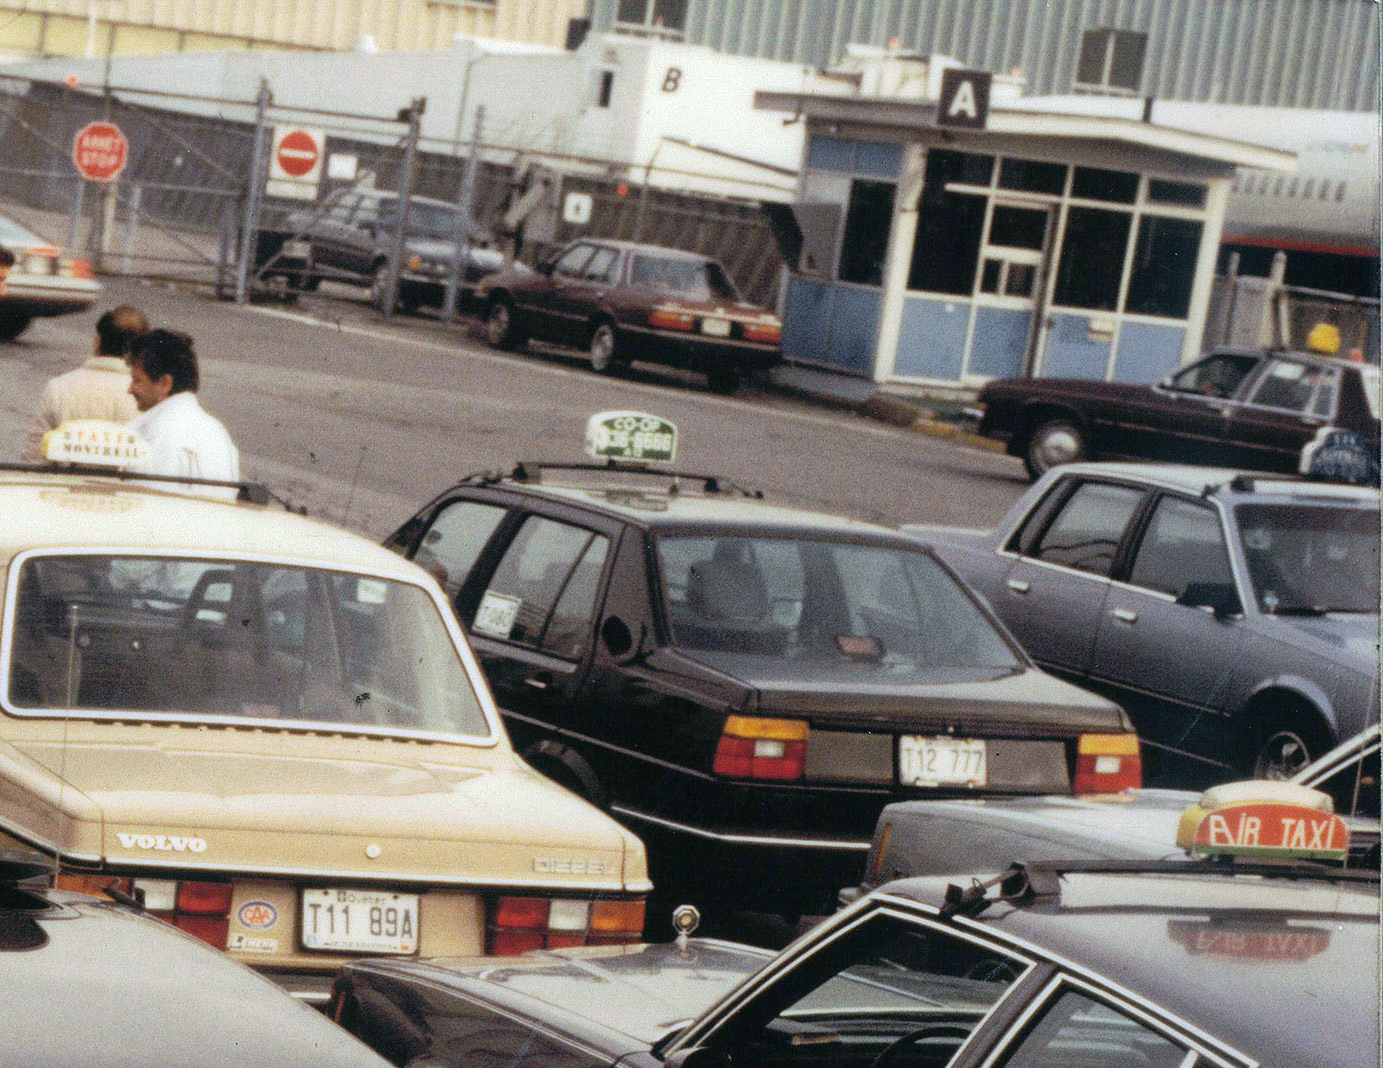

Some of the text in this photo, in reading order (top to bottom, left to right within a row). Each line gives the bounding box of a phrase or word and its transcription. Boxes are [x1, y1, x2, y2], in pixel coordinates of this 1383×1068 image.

[661, 68, 682, 93] B
[947, 80, 978, 118] A
[63, 443, 138, 458] MONTREAL
[904, 747, 984, 775] T12 777
[116, 831, 207, 854] VOLVO
[309, 903, 414, 939] T11 89A
